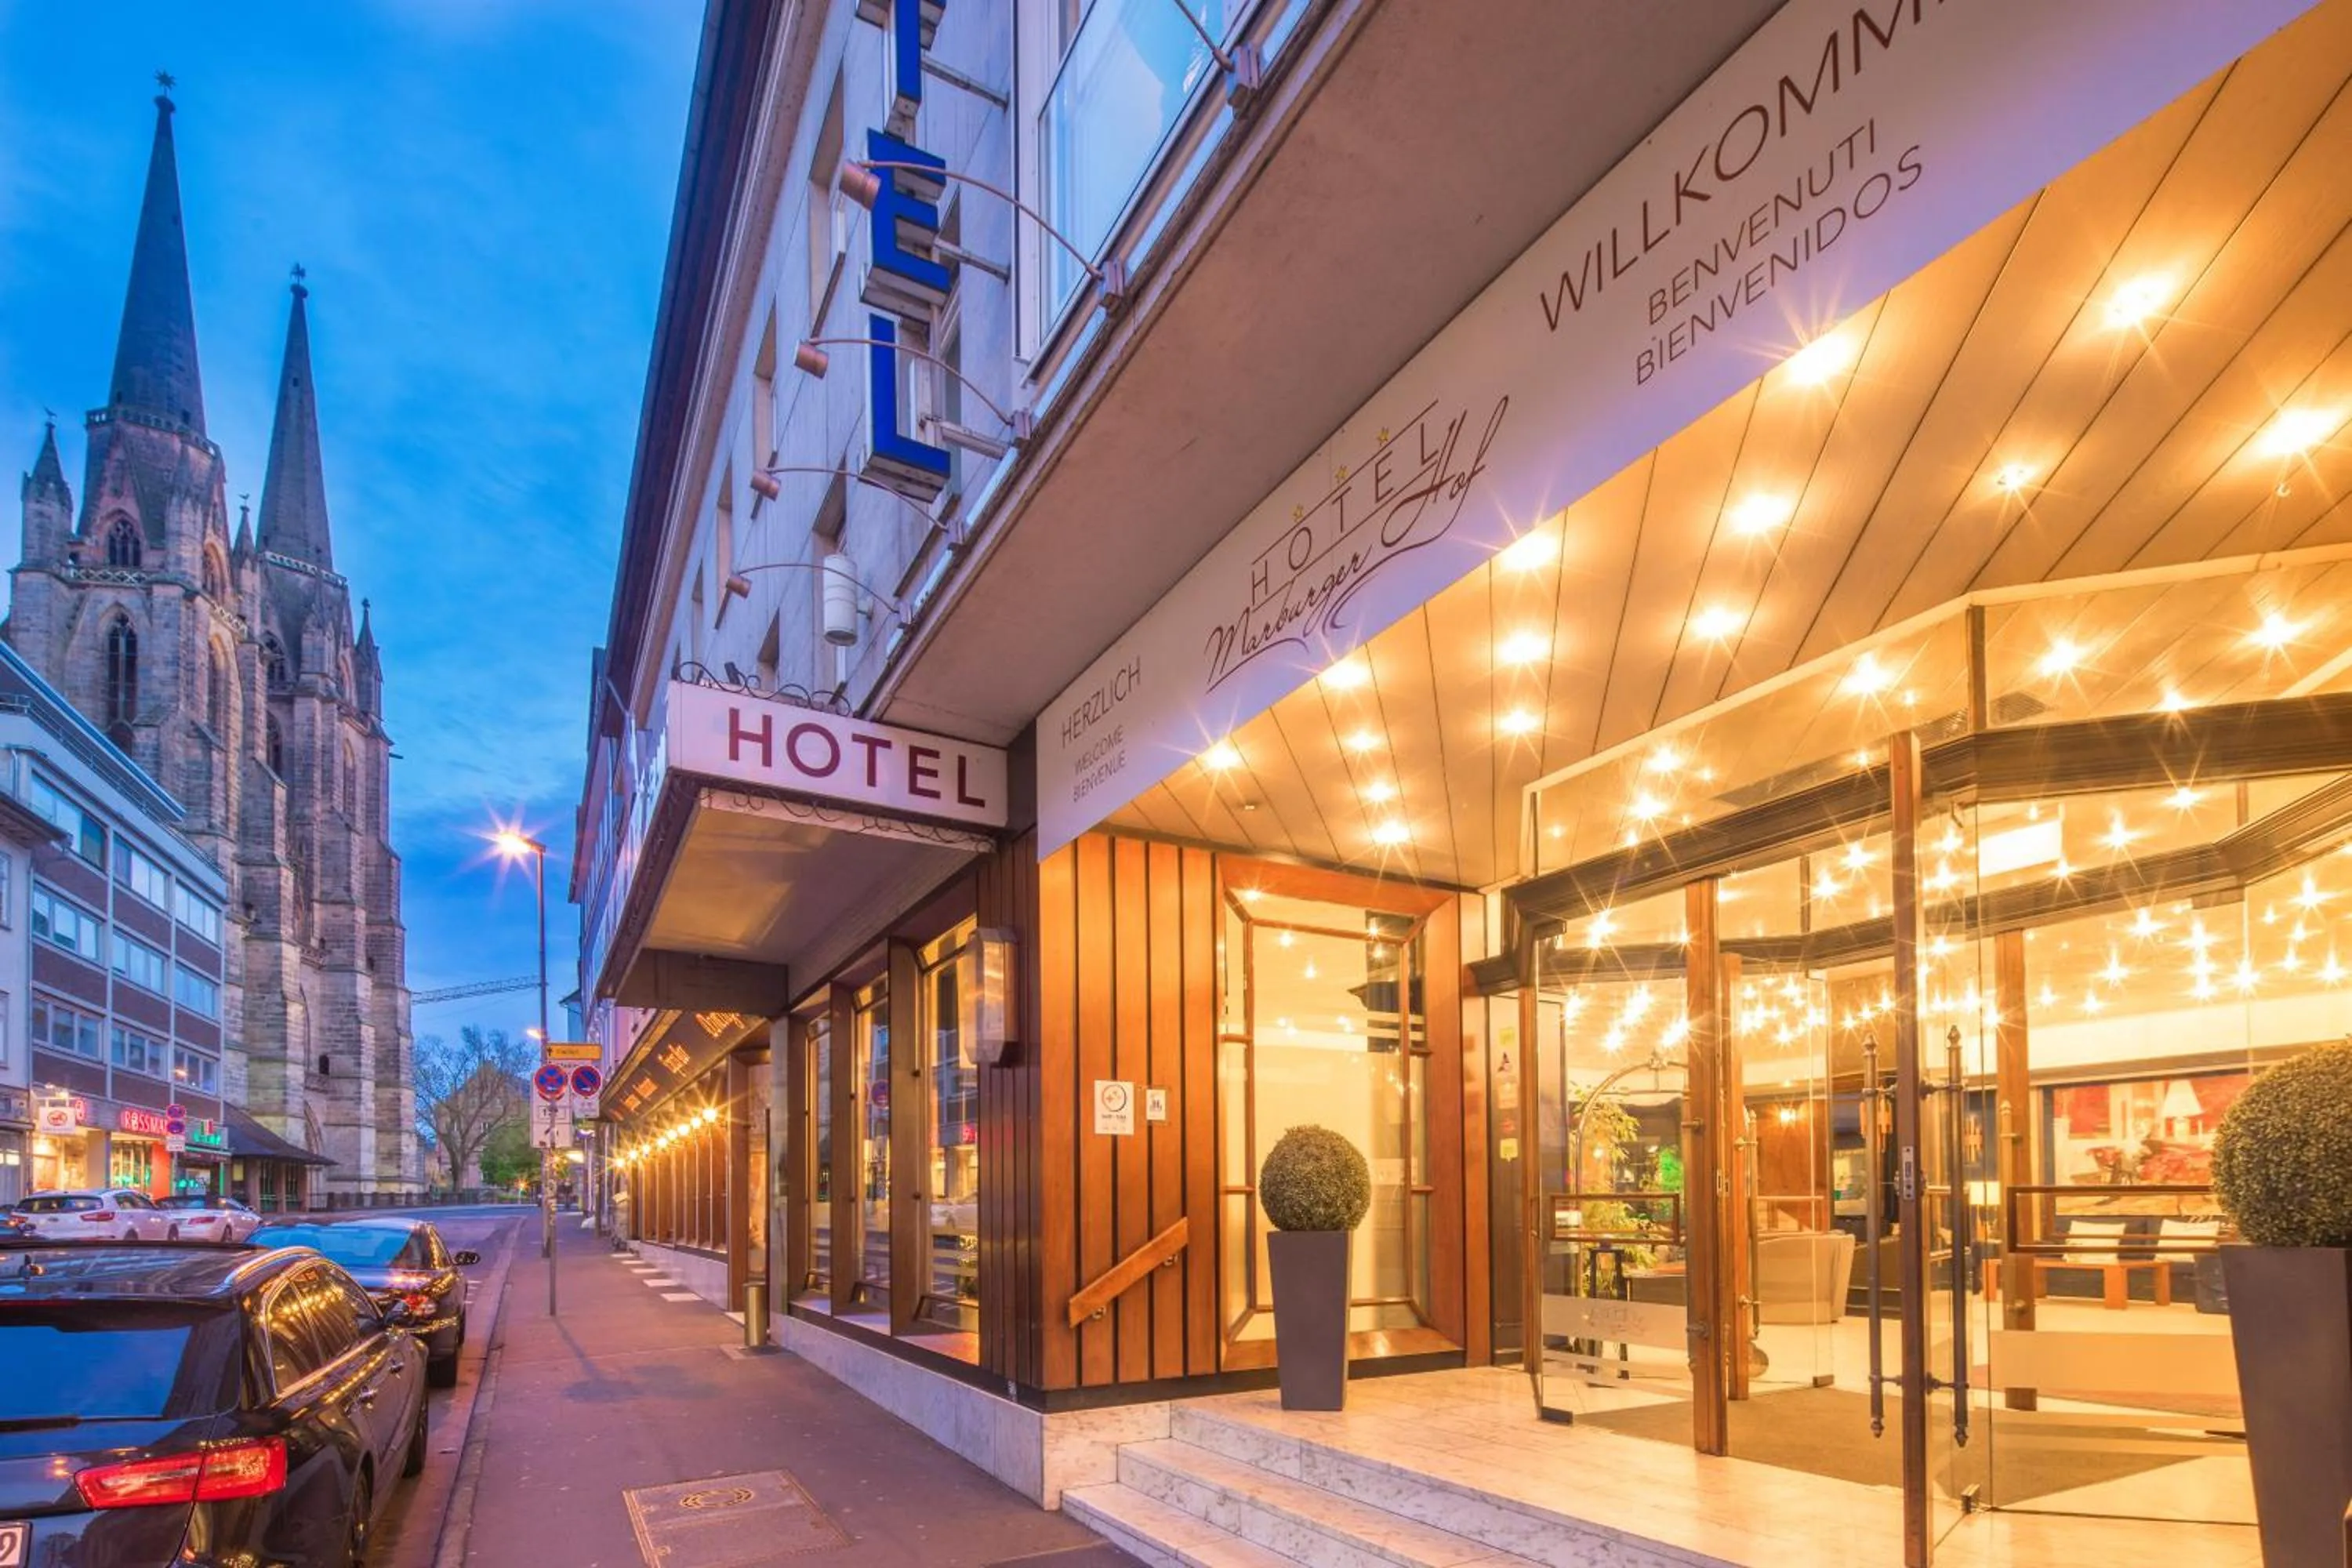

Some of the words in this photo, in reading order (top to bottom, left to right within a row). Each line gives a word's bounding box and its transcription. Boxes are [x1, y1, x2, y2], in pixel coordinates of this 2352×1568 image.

[1539, 0, 1945, 333] WILLKOMM
[1648, 118, 1876, 326] BENVENUTI
[1635, 145, 1922, 386] BIENVENIDOS
[1204, 544, 1373, 685] Marburger
[1381, 394, 1509, 547] Hof
[1250, 423, 1439, 605] HOTEL
[728, 707, 985, 808] HOTEL
[1062, 655, 1141, 749] HERZLICH
[1074, 724, 1123, 775] WELCOME
[1073, 750, 1127, 803] BIENVENUE
[125, 1109, 168, 1134] ROSSMA
